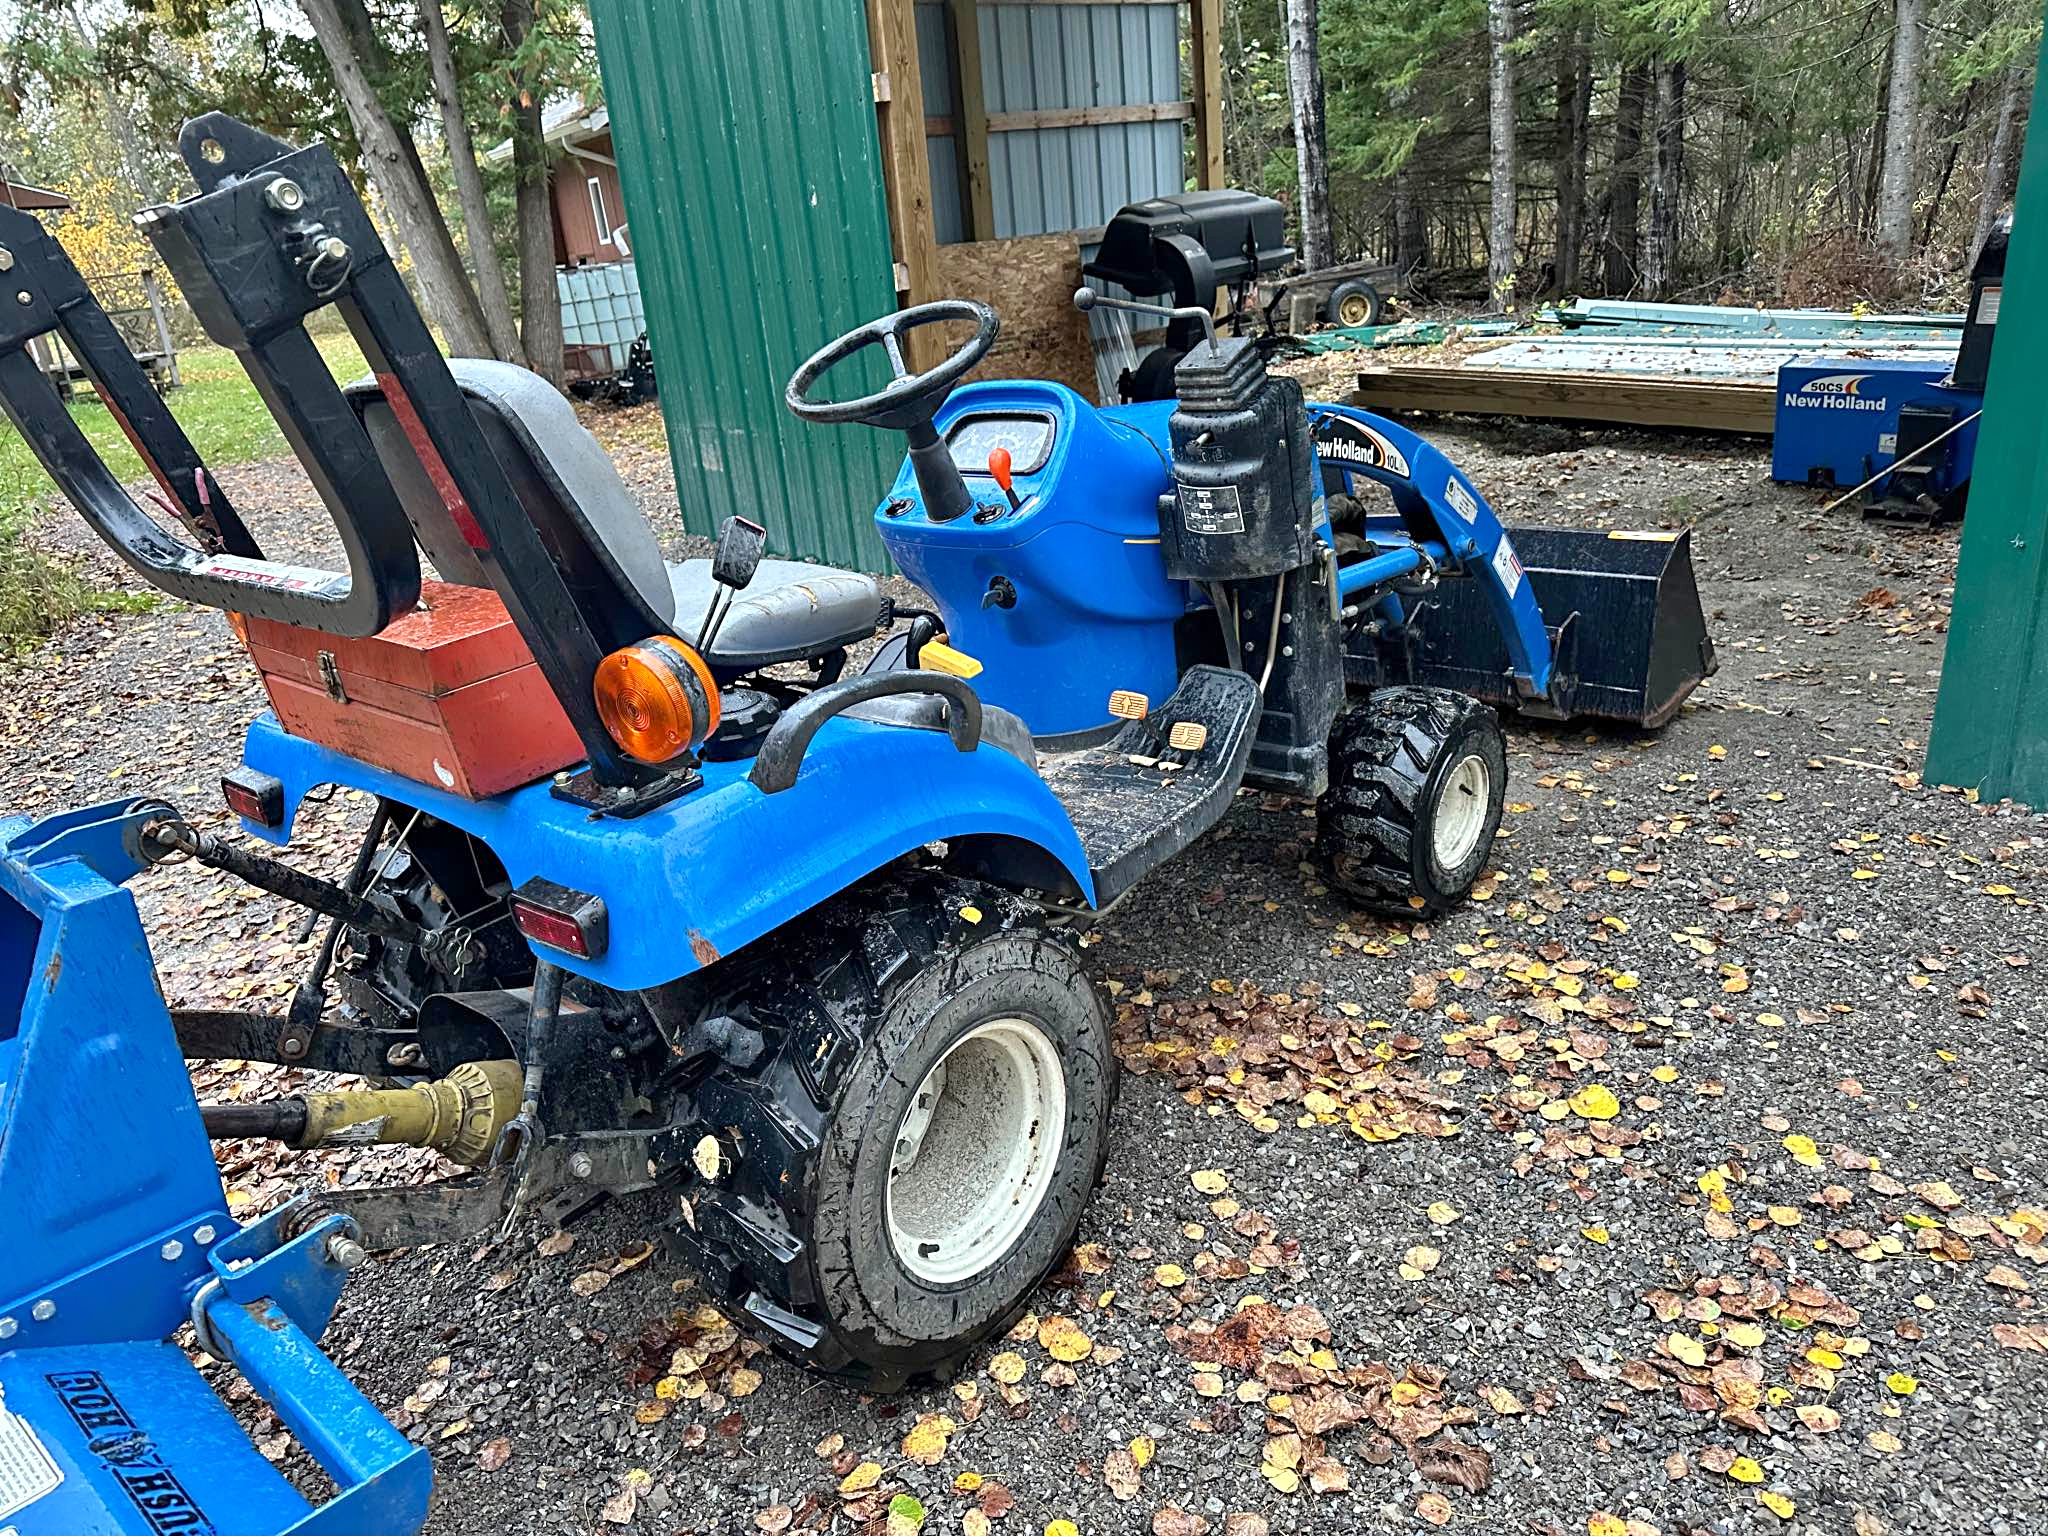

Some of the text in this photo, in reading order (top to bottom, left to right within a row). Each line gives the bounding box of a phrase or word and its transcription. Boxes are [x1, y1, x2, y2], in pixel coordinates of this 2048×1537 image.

[1810, 382, 1843, 392] 50CS
[1785, 394, 1886, 411] New Holland
[1316, 438, 1374, 464] ew Holland
[58, 1376, 201, 1537] USH HOG
